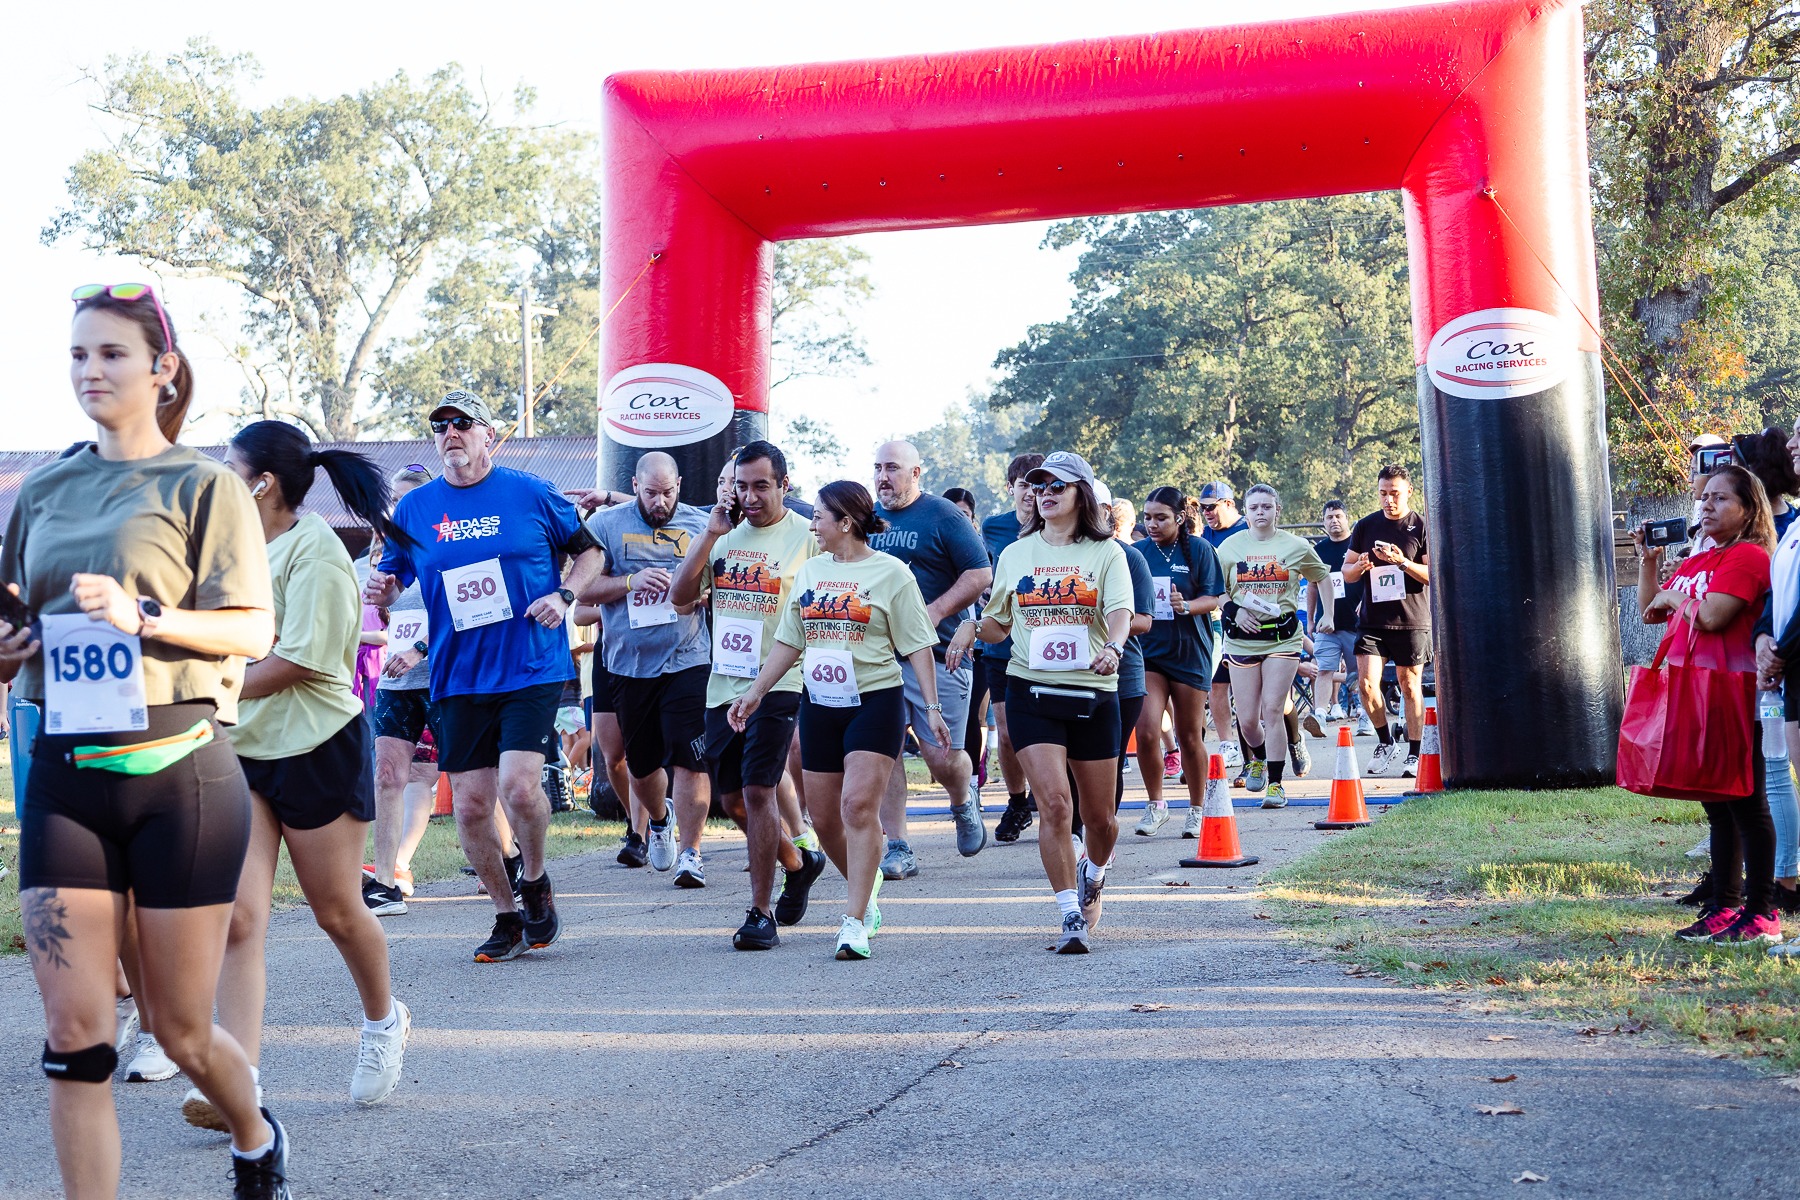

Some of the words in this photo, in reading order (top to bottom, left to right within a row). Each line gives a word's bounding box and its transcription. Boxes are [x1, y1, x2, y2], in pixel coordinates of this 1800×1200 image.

[1466, 341, 1534, 359] Cox
[1455, 361, 1493, 373] RACING
[1496, 358, 1547, 369] SERVICES
[629, 393, 690, 410] Cox
[620, 412, 651, 421] RACING
[653, 412, 701, 420] SERVICES
[439, 515, 501, 533] BADASS
[866, 530, 919, 550] TRONG
[1378, 574, 1396, 587] 171
[456, 576, 497, 603] 530
[727, 600, 757, 611] RANCH
[758, 603, 778, 614] RUN
[752, 594, 779, 605] TEXAS
[1021, 608, 1069, 618] EVERYTHING
[1070, 607, 1095, 616] TEXAS
[1043, 615, 1079, 626] RANCH
[1079, 616, 1094, 625] UN
[394, 622, 422, 639] 587
[804, 622, 841, 632] ERYTHING
[842, 622, 867, 632] TEXAS
[721, 632, 753, 653] 652
[819, 630, 847, 642] RANCH
[848, 631, 865, 642] RUN
[1042, 641, 1077, 660] 631
[50, 642, 133, 682] 1580
[811, 663, 847, 684] 630
